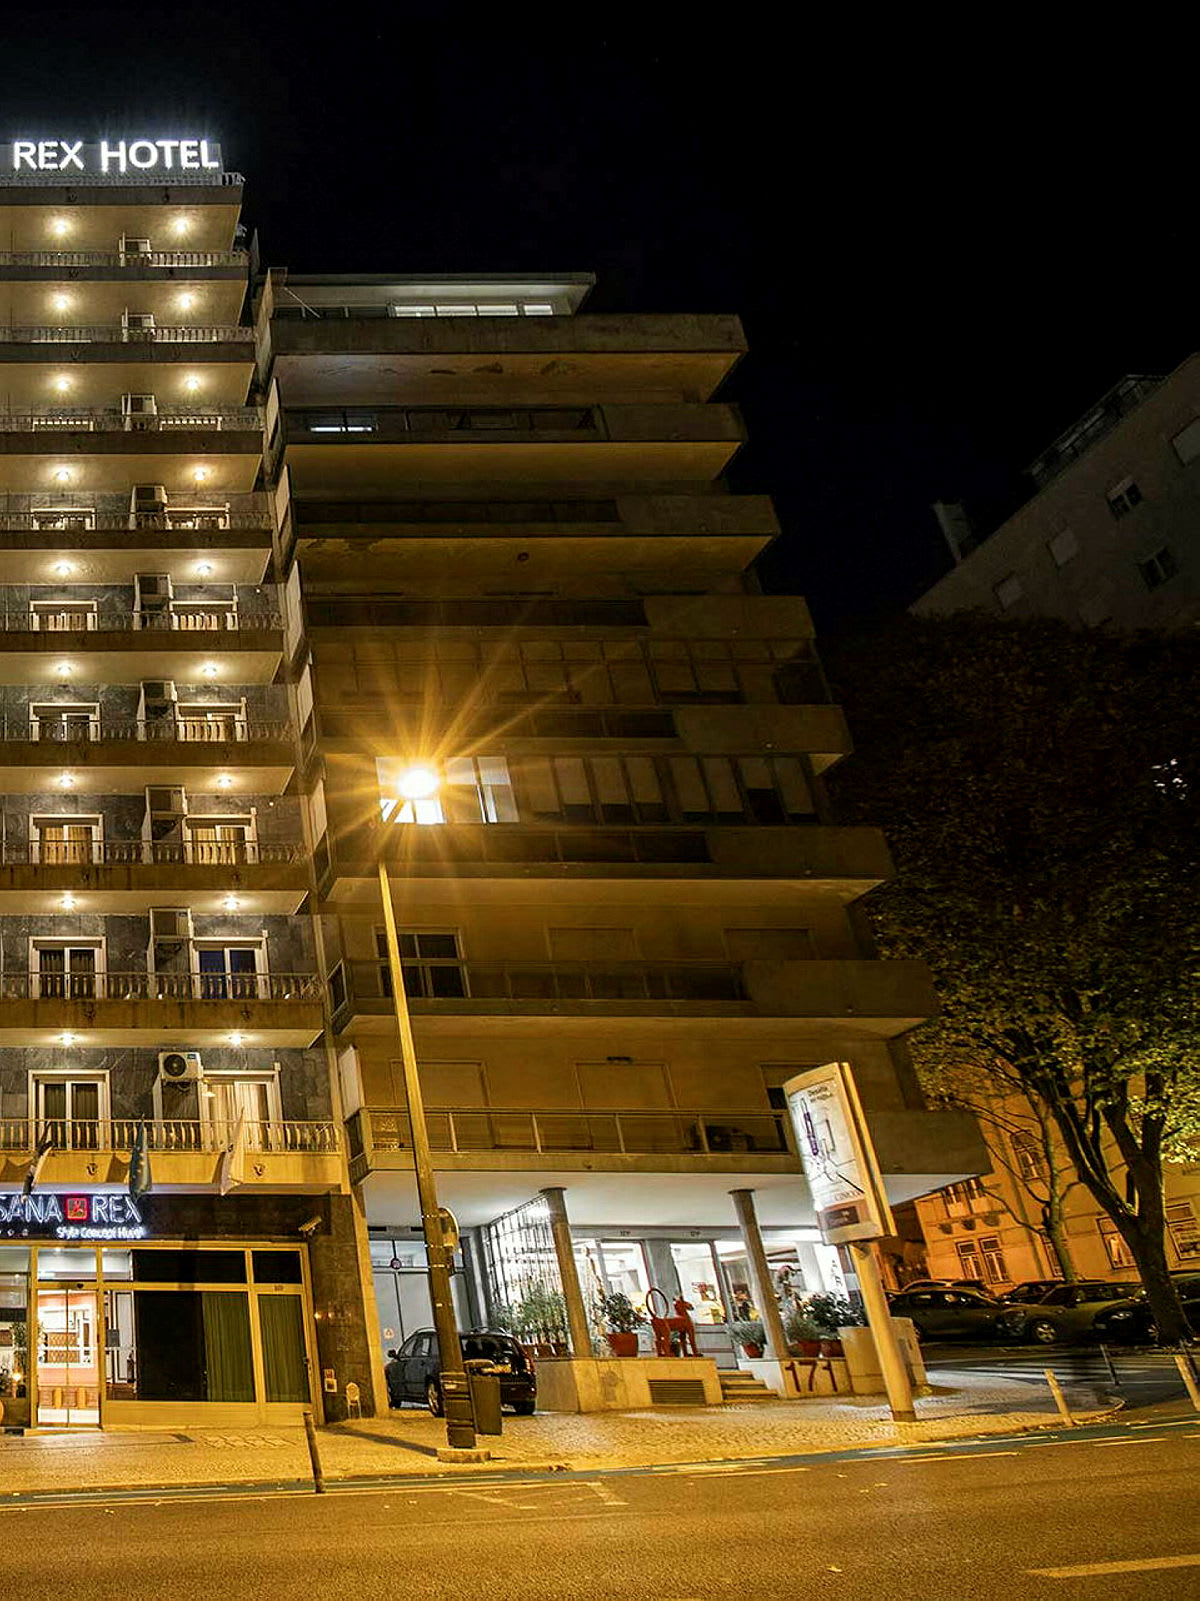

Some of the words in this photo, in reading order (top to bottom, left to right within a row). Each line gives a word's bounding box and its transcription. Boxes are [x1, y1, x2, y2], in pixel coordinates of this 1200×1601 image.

[13, 141, 85, 171] REX
[100, 140, 220, 172] HOTEL
[92, 1194, 142, 1223] REX
[784, 1360, 838, 1393] 171
